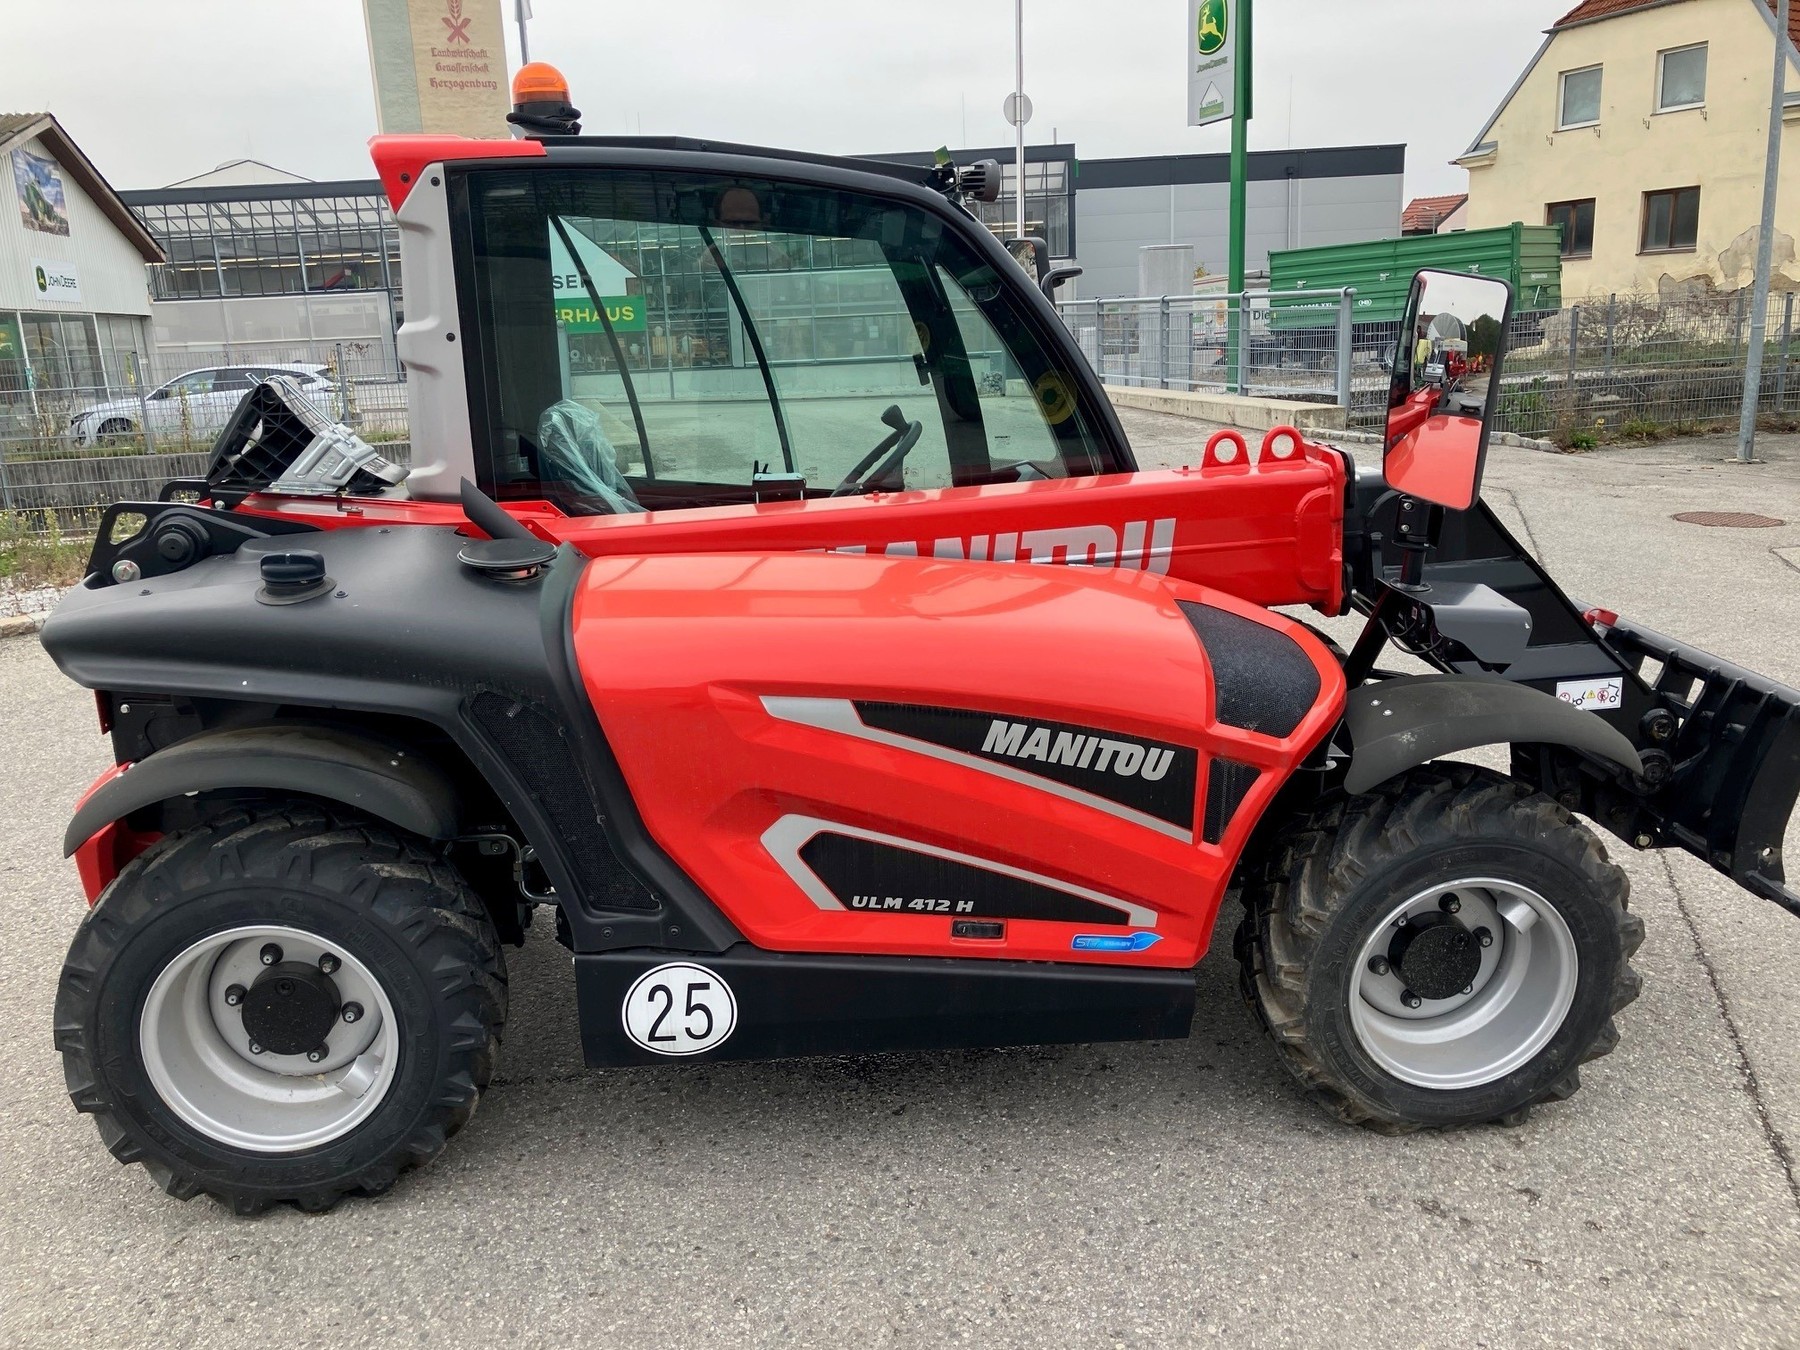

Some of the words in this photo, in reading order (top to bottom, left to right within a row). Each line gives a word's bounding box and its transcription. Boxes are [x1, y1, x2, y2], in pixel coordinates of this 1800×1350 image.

[429, 77, 498, 90] Herzogenburg
[981, 719, 1175, 781] MANITOU
[852, 896, 903, 909] ULM
[908, 899, 951, 911] 412
[956, 901, 974, 912] H
[647, 982, 714, 1042] 25
